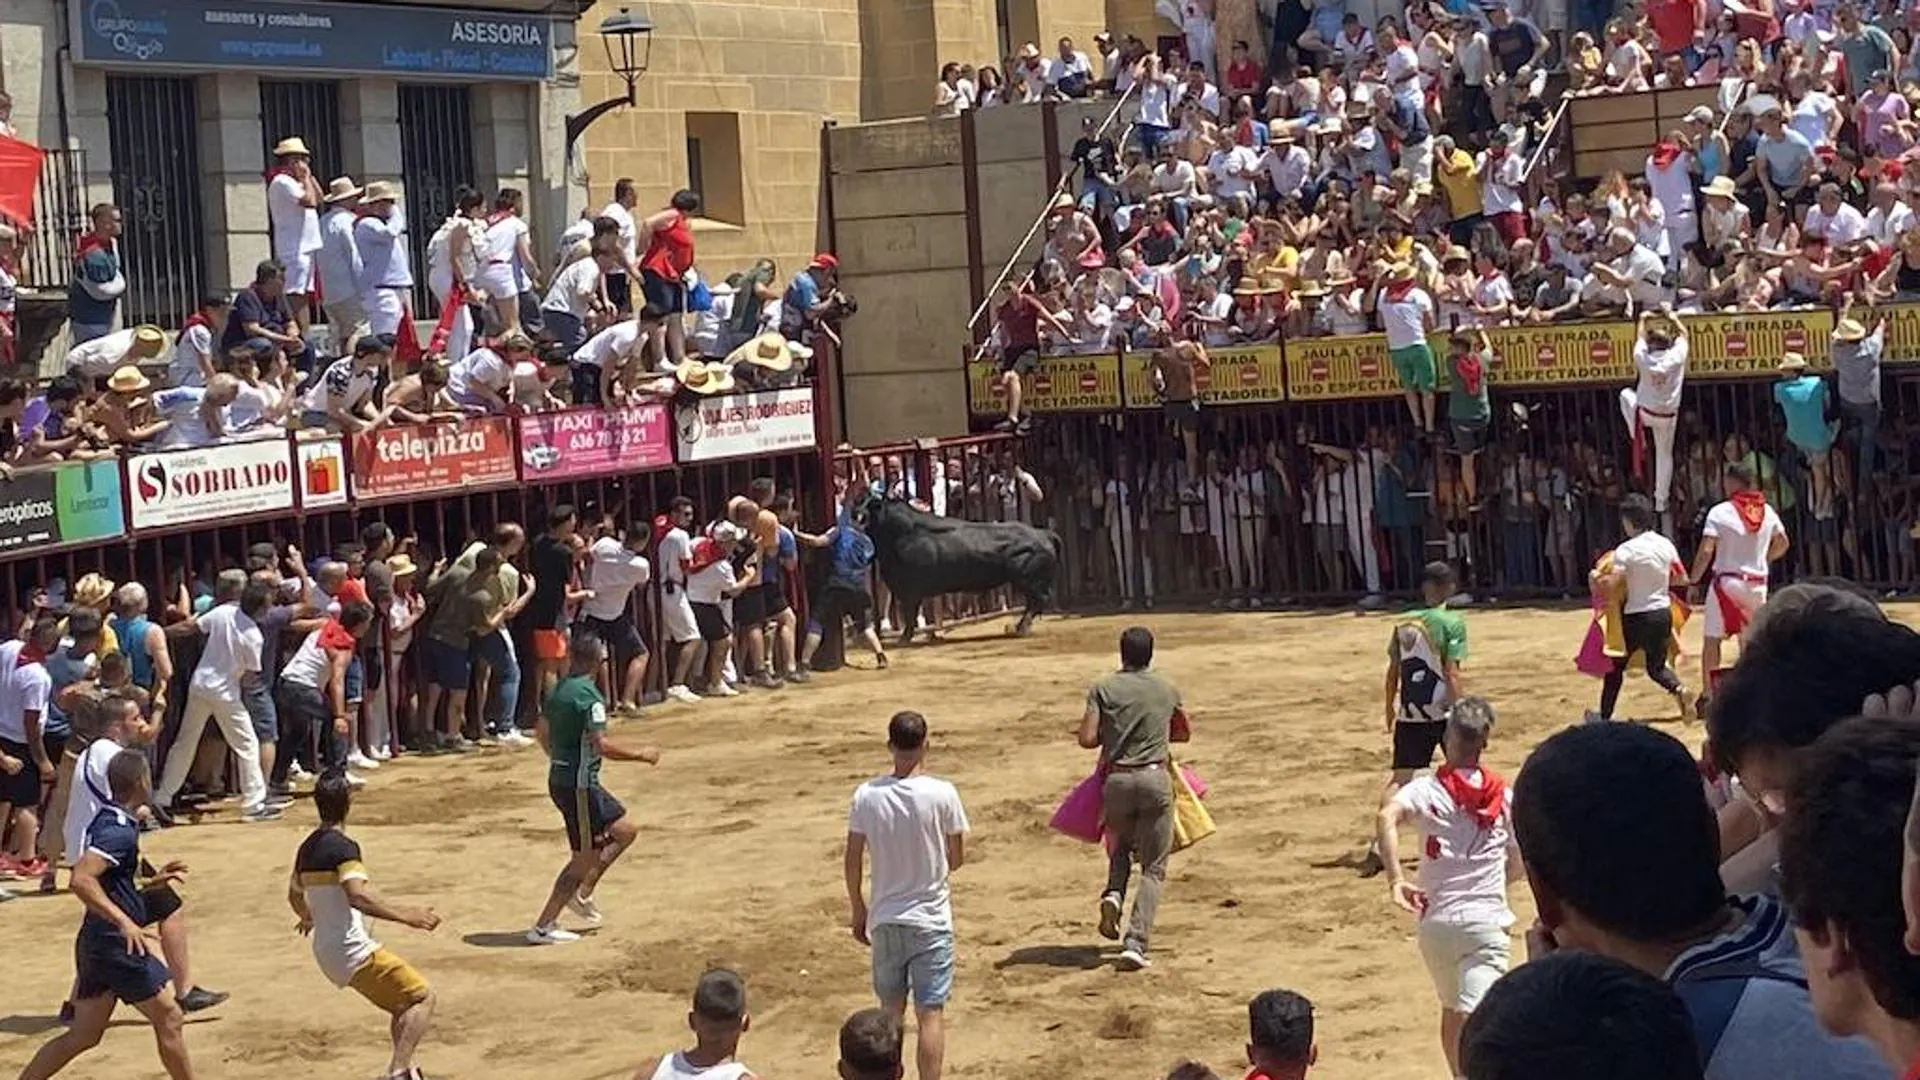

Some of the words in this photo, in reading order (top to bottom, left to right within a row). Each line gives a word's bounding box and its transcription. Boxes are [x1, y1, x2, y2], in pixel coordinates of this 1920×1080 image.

[452, 20, 541, 45] ASESORÍA
[1720, 319, 1806, 333] CERRADA
[1531, 329, 1613, 343] CERRADA
[1503, 365, 1636, 381] ESPECTADORES
[1291, 383, 1324, 395] USO
[553, 414, 593, 433] TAXI
[376, 426, 486, 466] telepizza
[569, 432, 594, 449] 636
[632, 426, 647, 442] 21
[171, 460, 288, 498] SOBRADO
